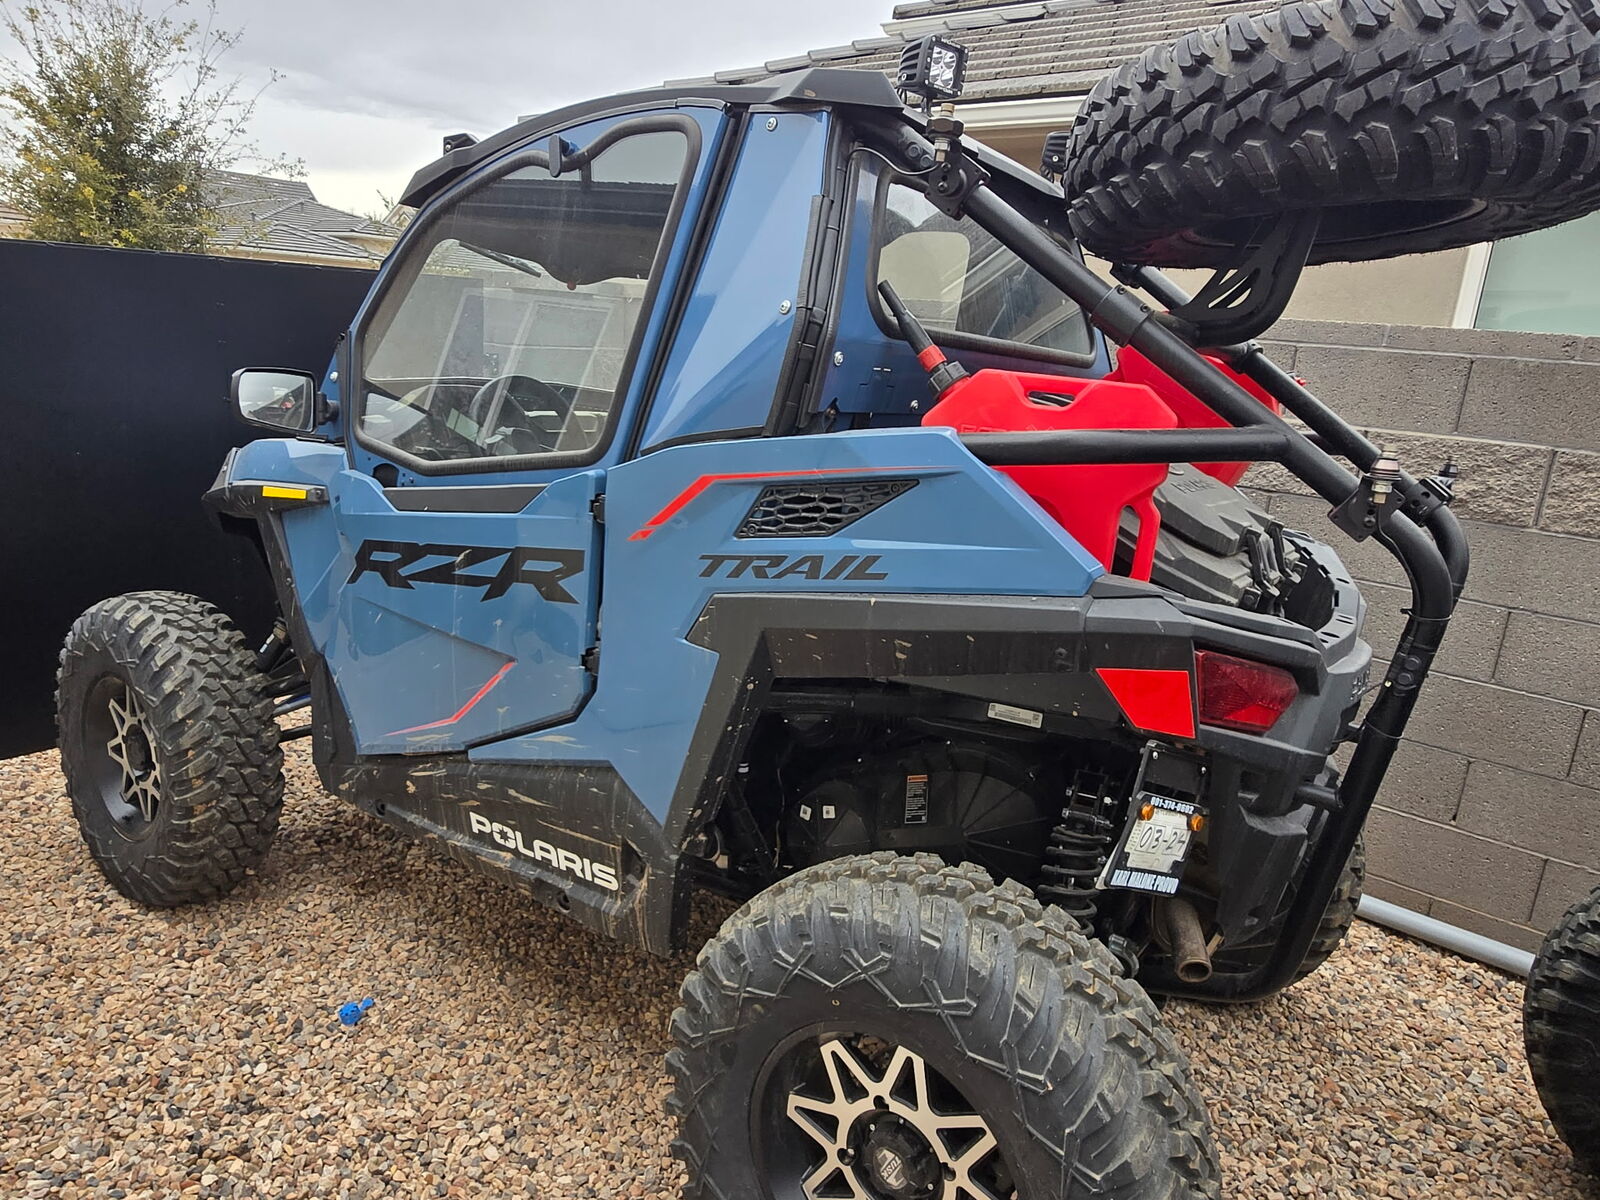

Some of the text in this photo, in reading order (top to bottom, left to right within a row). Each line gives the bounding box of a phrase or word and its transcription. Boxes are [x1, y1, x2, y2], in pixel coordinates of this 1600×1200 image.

[347, 539, 585, 604] RZR
[699, 554, 889, 581] TRAIL
[469, 811, 619, 891] POLARIS
[1127, 871, 1157, 890] MALONE
[1153, 875, 1179, 894] PROVO
[881, 1155, 902, 1180] TUSK
